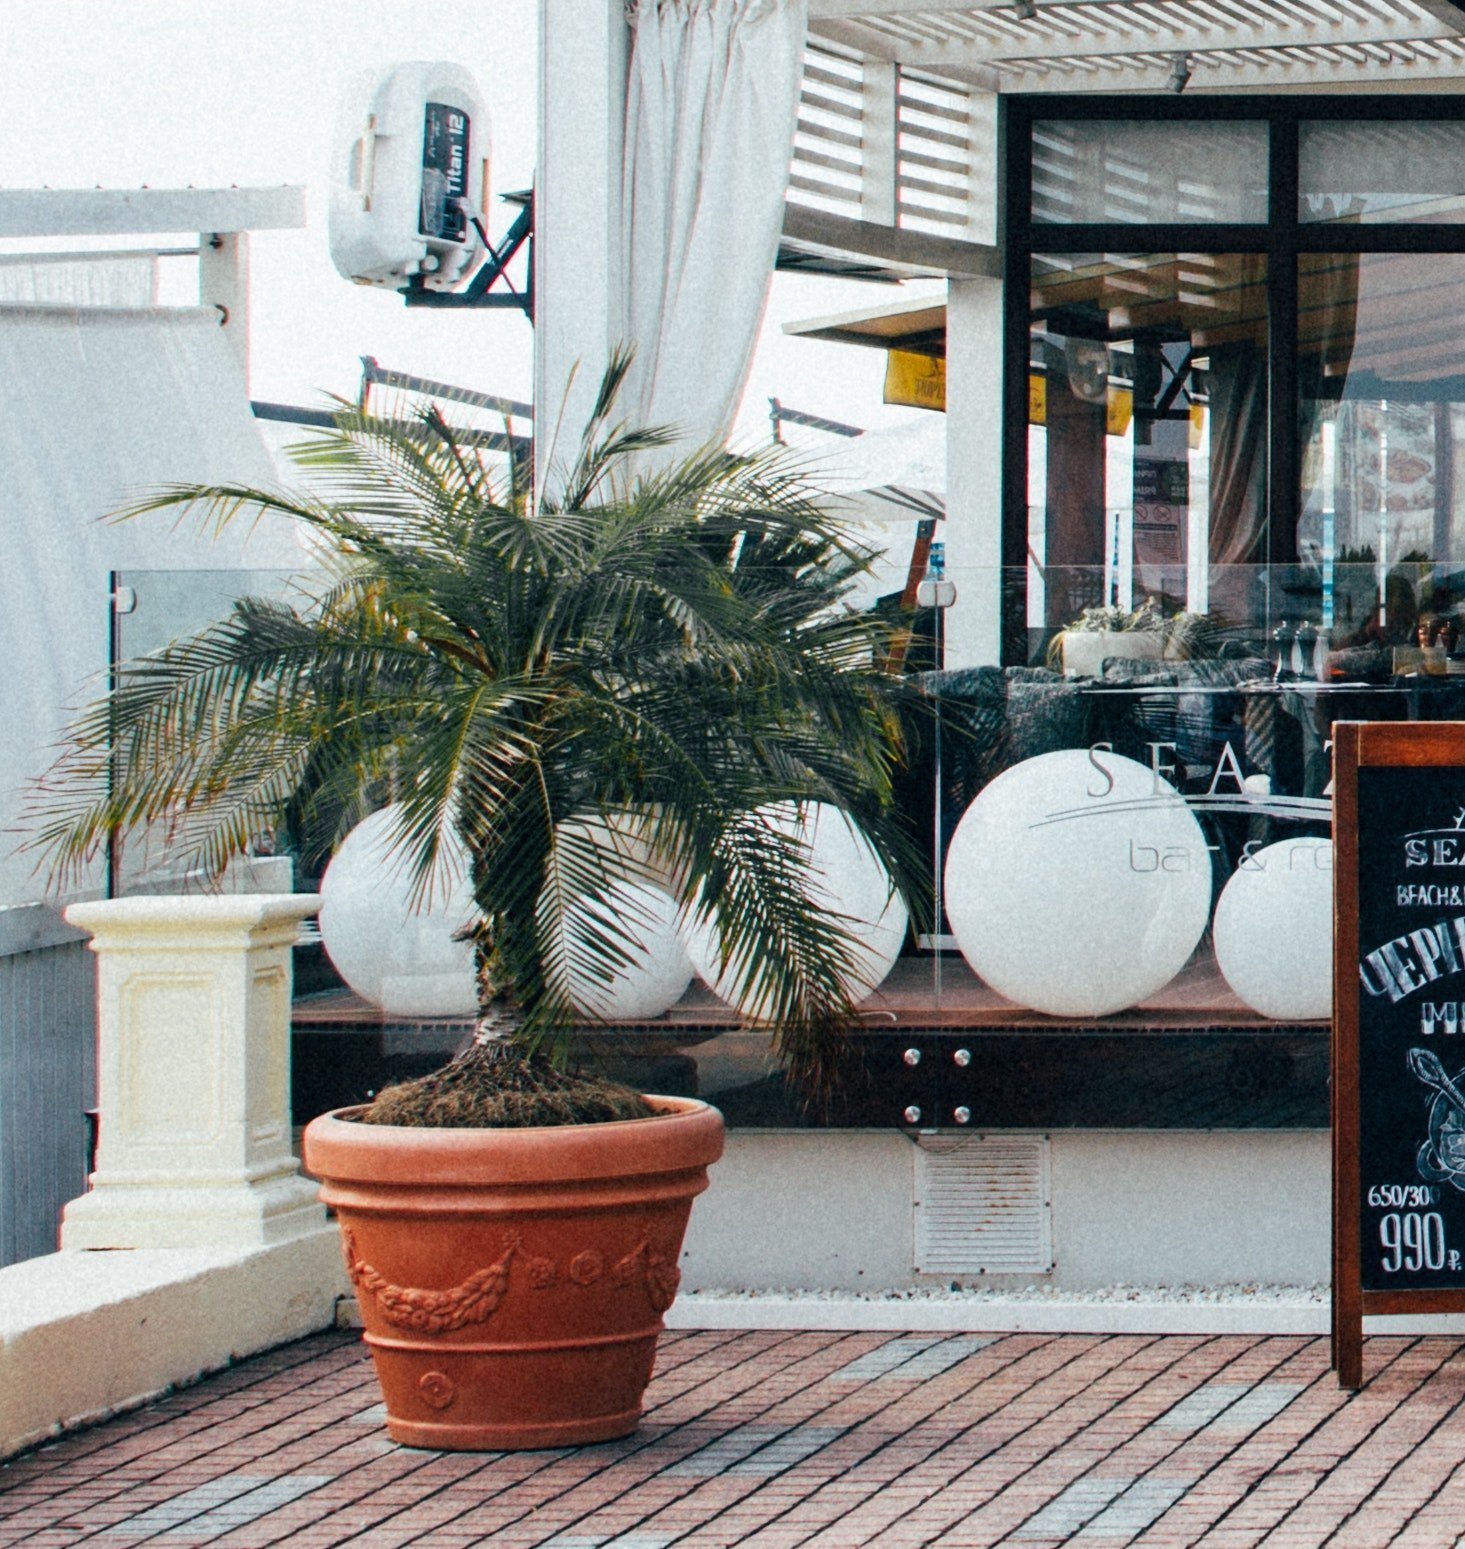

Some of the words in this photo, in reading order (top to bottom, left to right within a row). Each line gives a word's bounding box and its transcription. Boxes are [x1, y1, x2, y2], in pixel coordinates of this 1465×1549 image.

[446, 145, 462, 194] Titan
[1087, 740, 1246, 798] SEA
[1237, 839, 1267, 873] &
